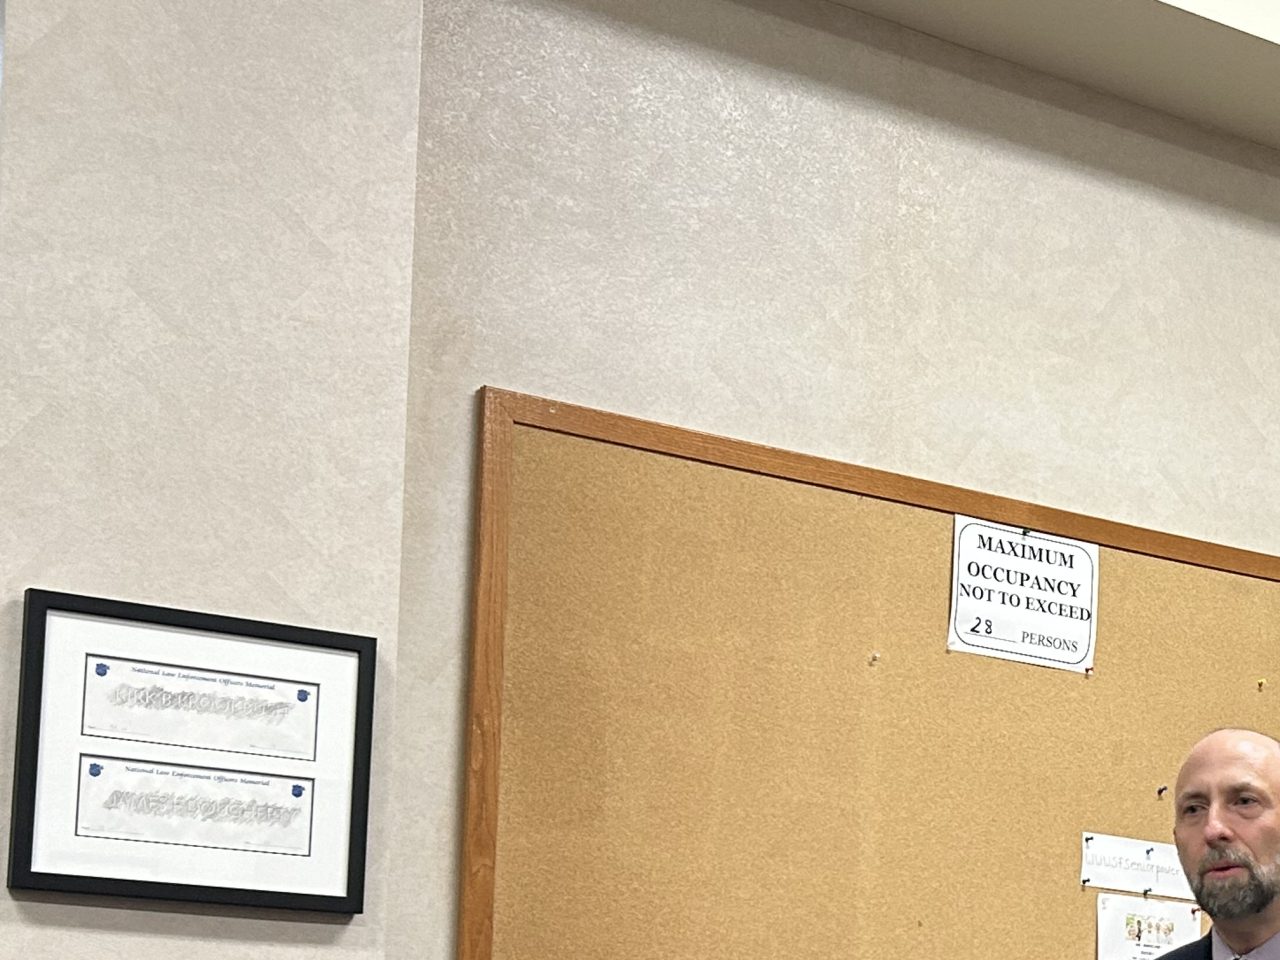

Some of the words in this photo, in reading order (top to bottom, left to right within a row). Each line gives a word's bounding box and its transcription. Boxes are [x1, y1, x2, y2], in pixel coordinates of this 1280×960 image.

[977, 534, 1075, 569] MAXIMUM
[967, 561, 1081, 598] OCCUPANCY
[960, 583, 996, 603] NOT
[998, 591, 1021, 608] TO
[1025, 596, 1092, 622] EXCEED
[970, 616, 993, 635] 28
[1021, 631, 1079, 654] PERSONS
